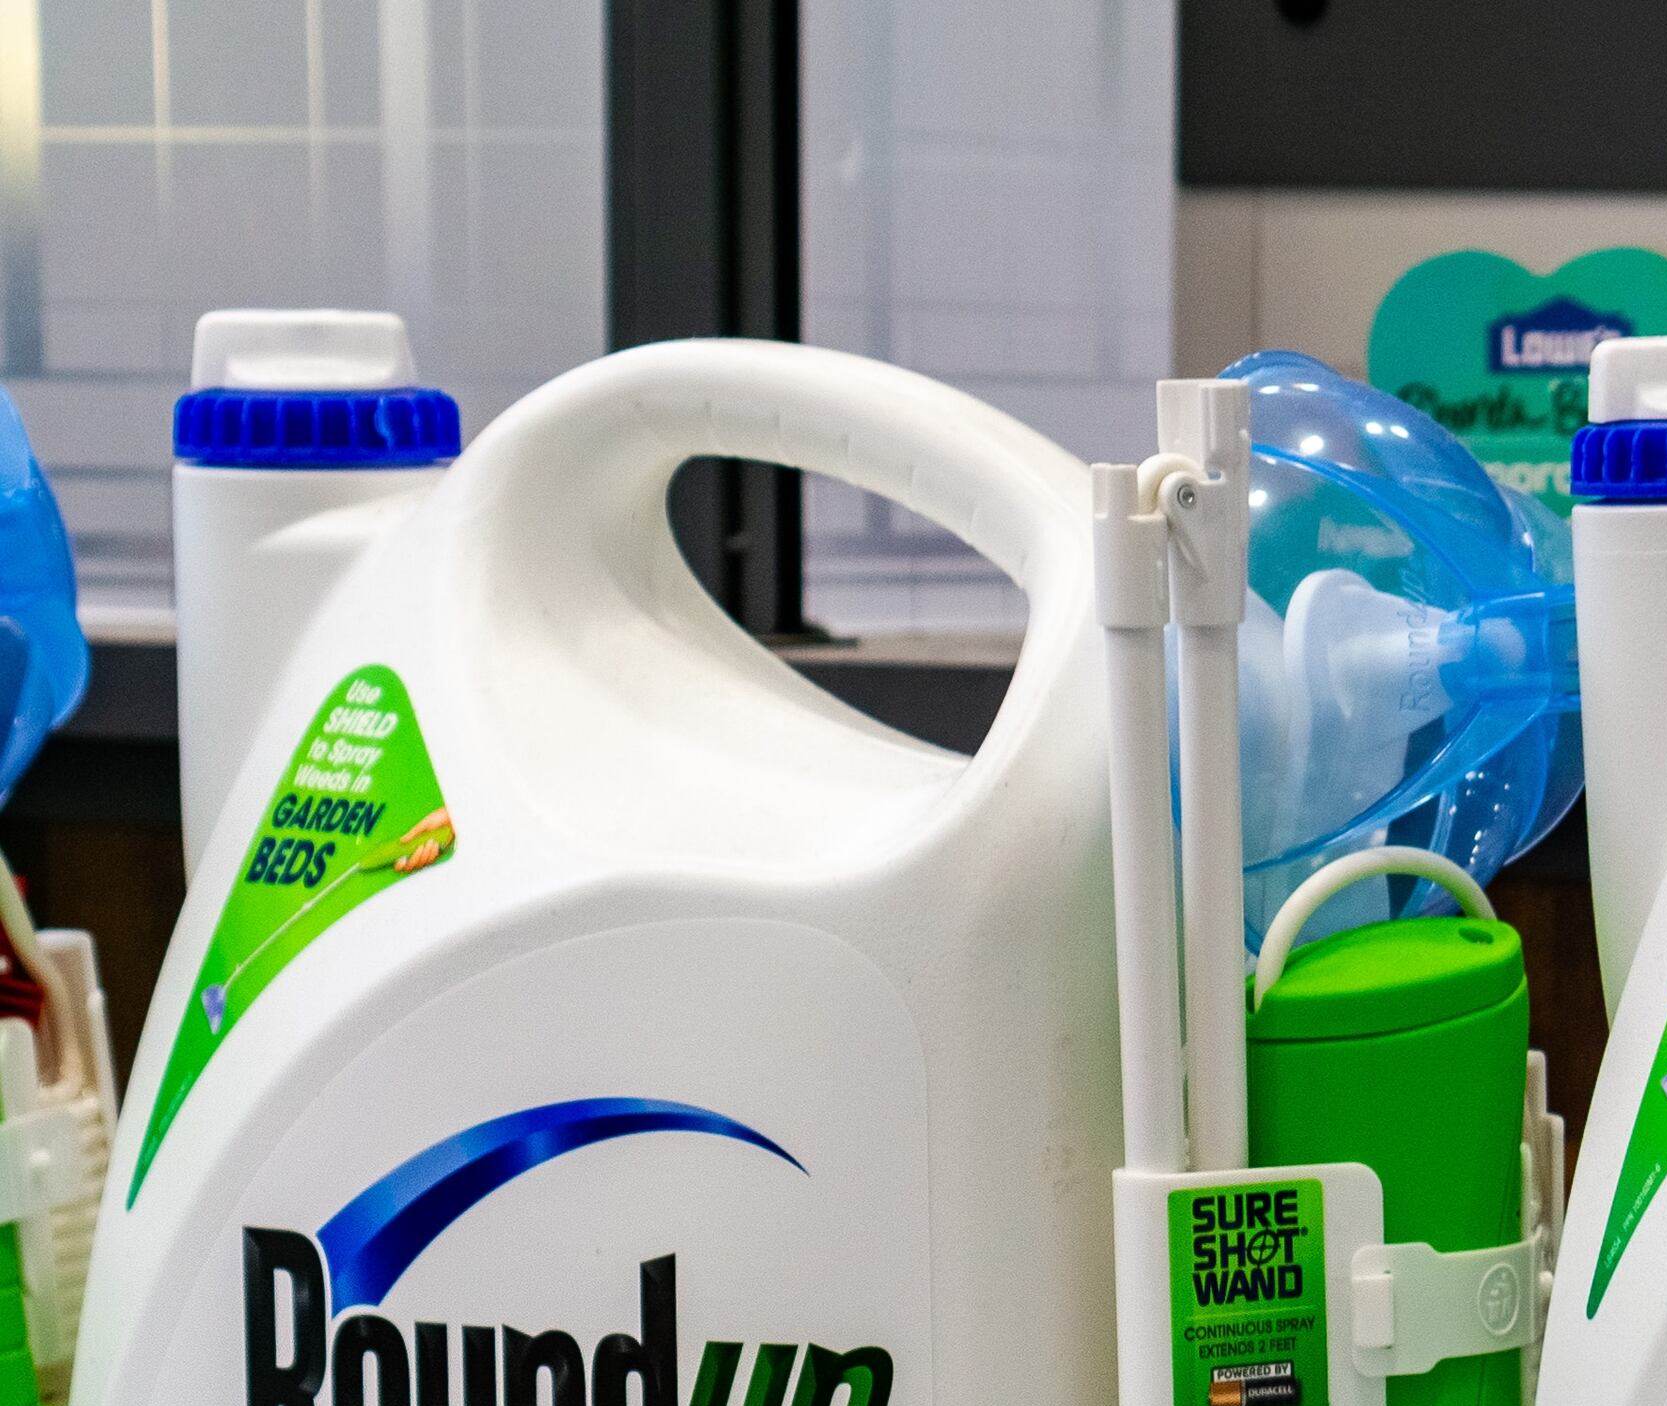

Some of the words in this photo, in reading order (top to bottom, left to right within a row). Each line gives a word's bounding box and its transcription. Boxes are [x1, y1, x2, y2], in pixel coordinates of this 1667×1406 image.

[323, 707, 398, 739] SHIELD
[272, 792, 387, 836] GARDEN
[244, 836, 336, 888] BEDS
[1192, 1190, 1298, 1232] SURE
[1193, 1227, 1301, 1271] SHOT
[1192, 1265, 1303, 1306] WAND
